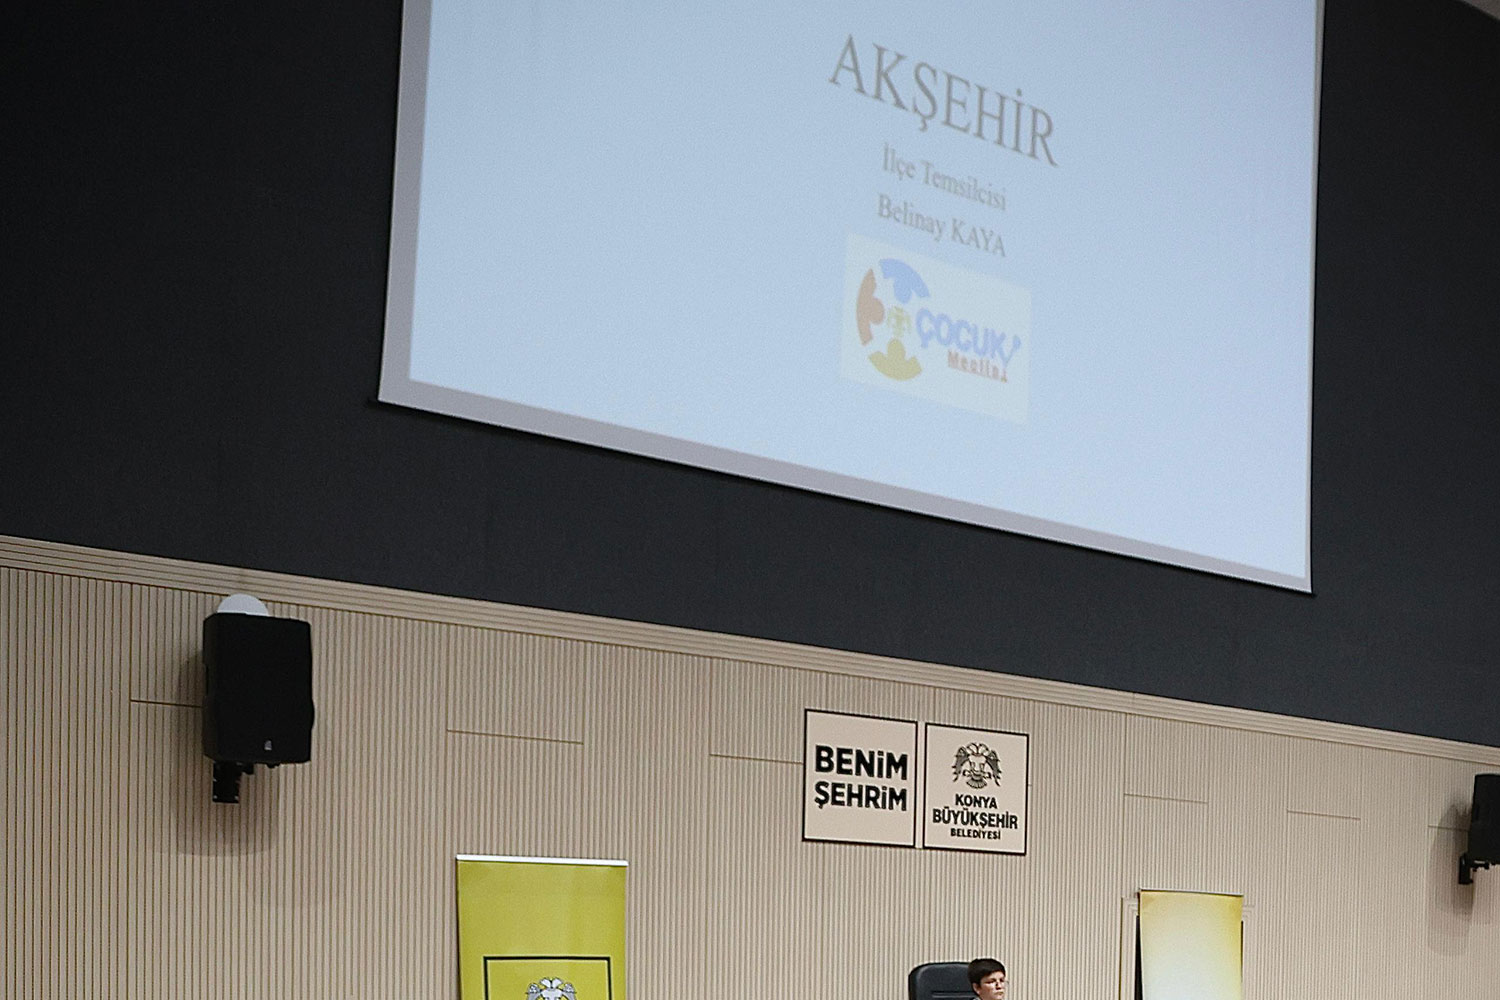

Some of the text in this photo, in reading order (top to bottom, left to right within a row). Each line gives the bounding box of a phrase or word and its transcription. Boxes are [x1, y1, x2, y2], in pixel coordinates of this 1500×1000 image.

[829, 34, 1059, 167] AKŞEHİR
[922, 161, 1007, 212] Temsilcisi
[877, 193, 1007, 257] Belinay KAYA
[932, 806, 1019, 830] BÜYÜKŞEHİR
[955, 793, 998, 809] KONYA
[950, 827, 1001, 840] BELEDİYESİ
